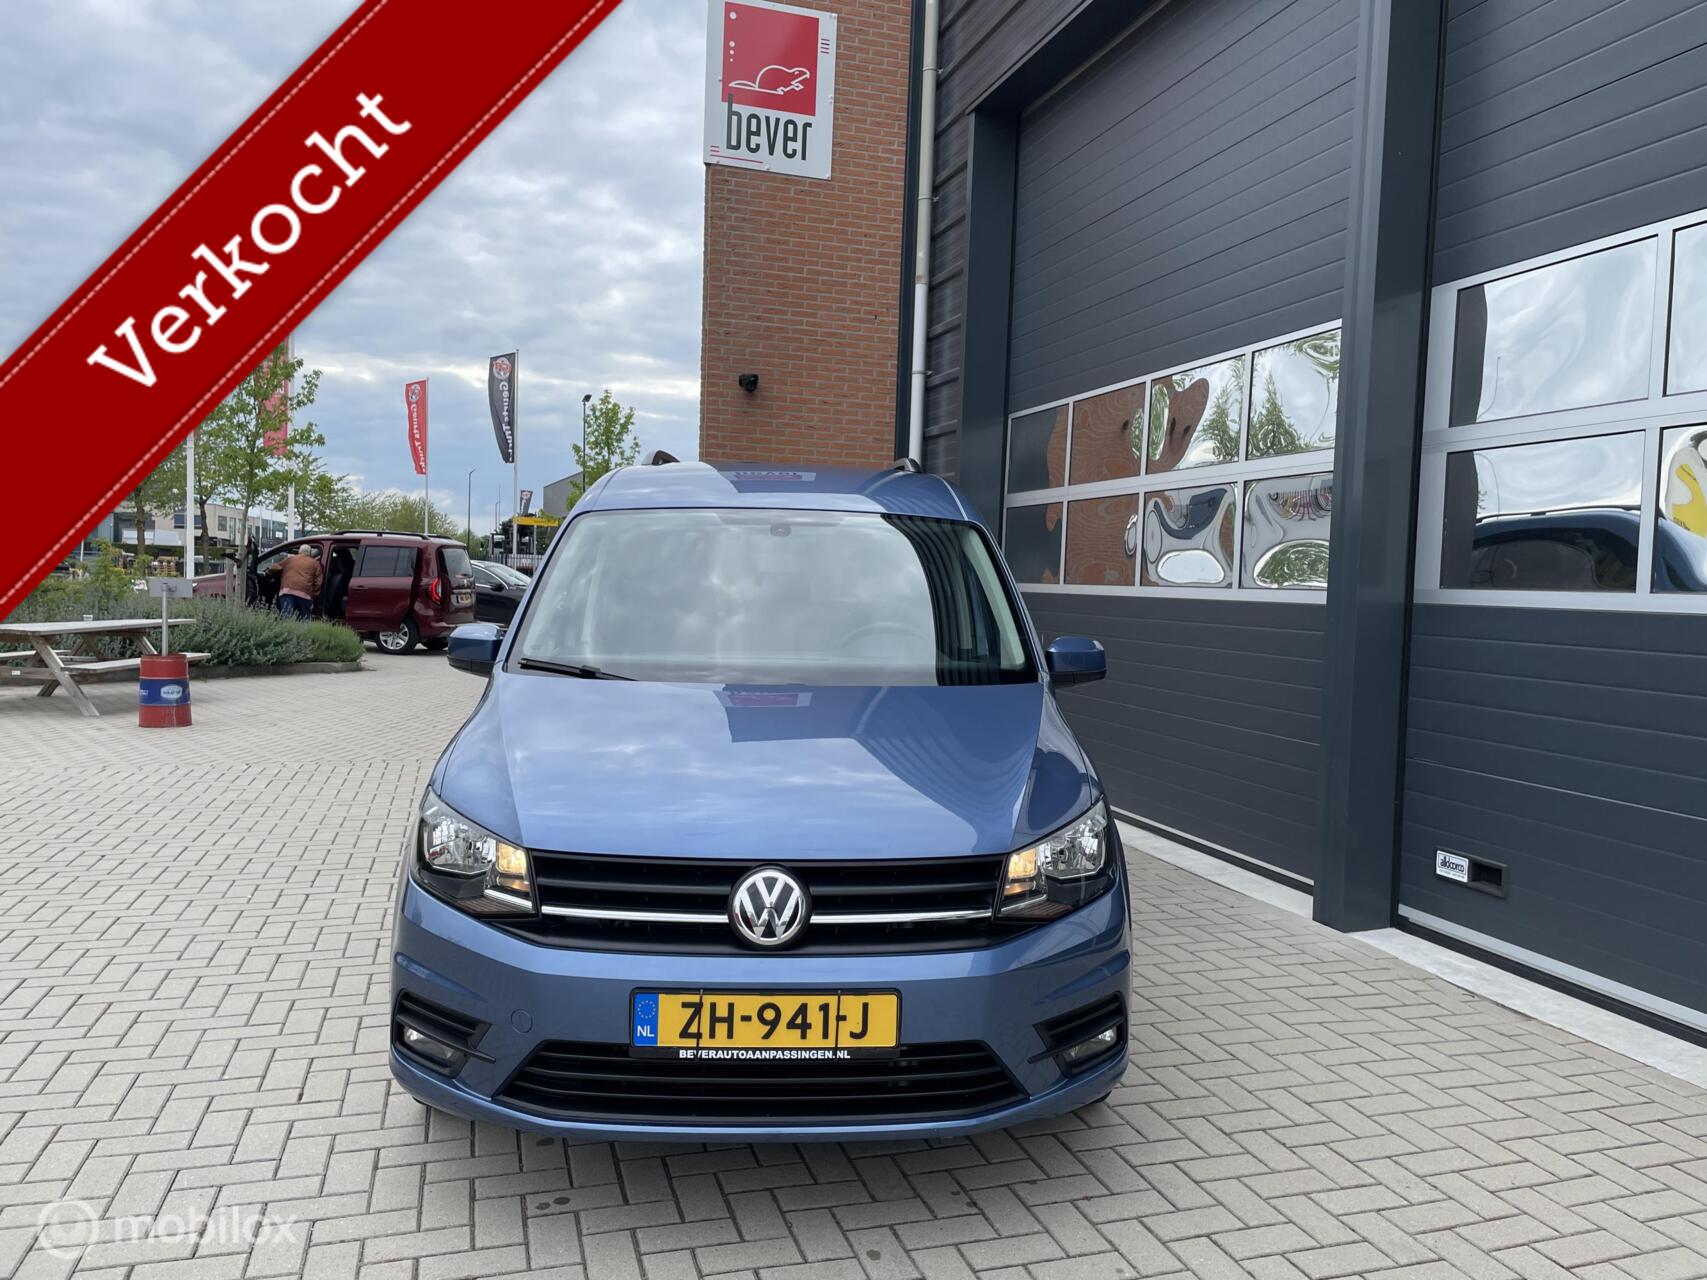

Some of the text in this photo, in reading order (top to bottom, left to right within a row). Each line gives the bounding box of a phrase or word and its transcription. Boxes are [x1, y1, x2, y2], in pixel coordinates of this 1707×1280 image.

[726, 93, 813, 161] bever
[637, 1001, 870, 1040] NL ZH-941-J
[679, 1049, 851, 1060] BEVERAUTOAANPASSINGEN.NL
